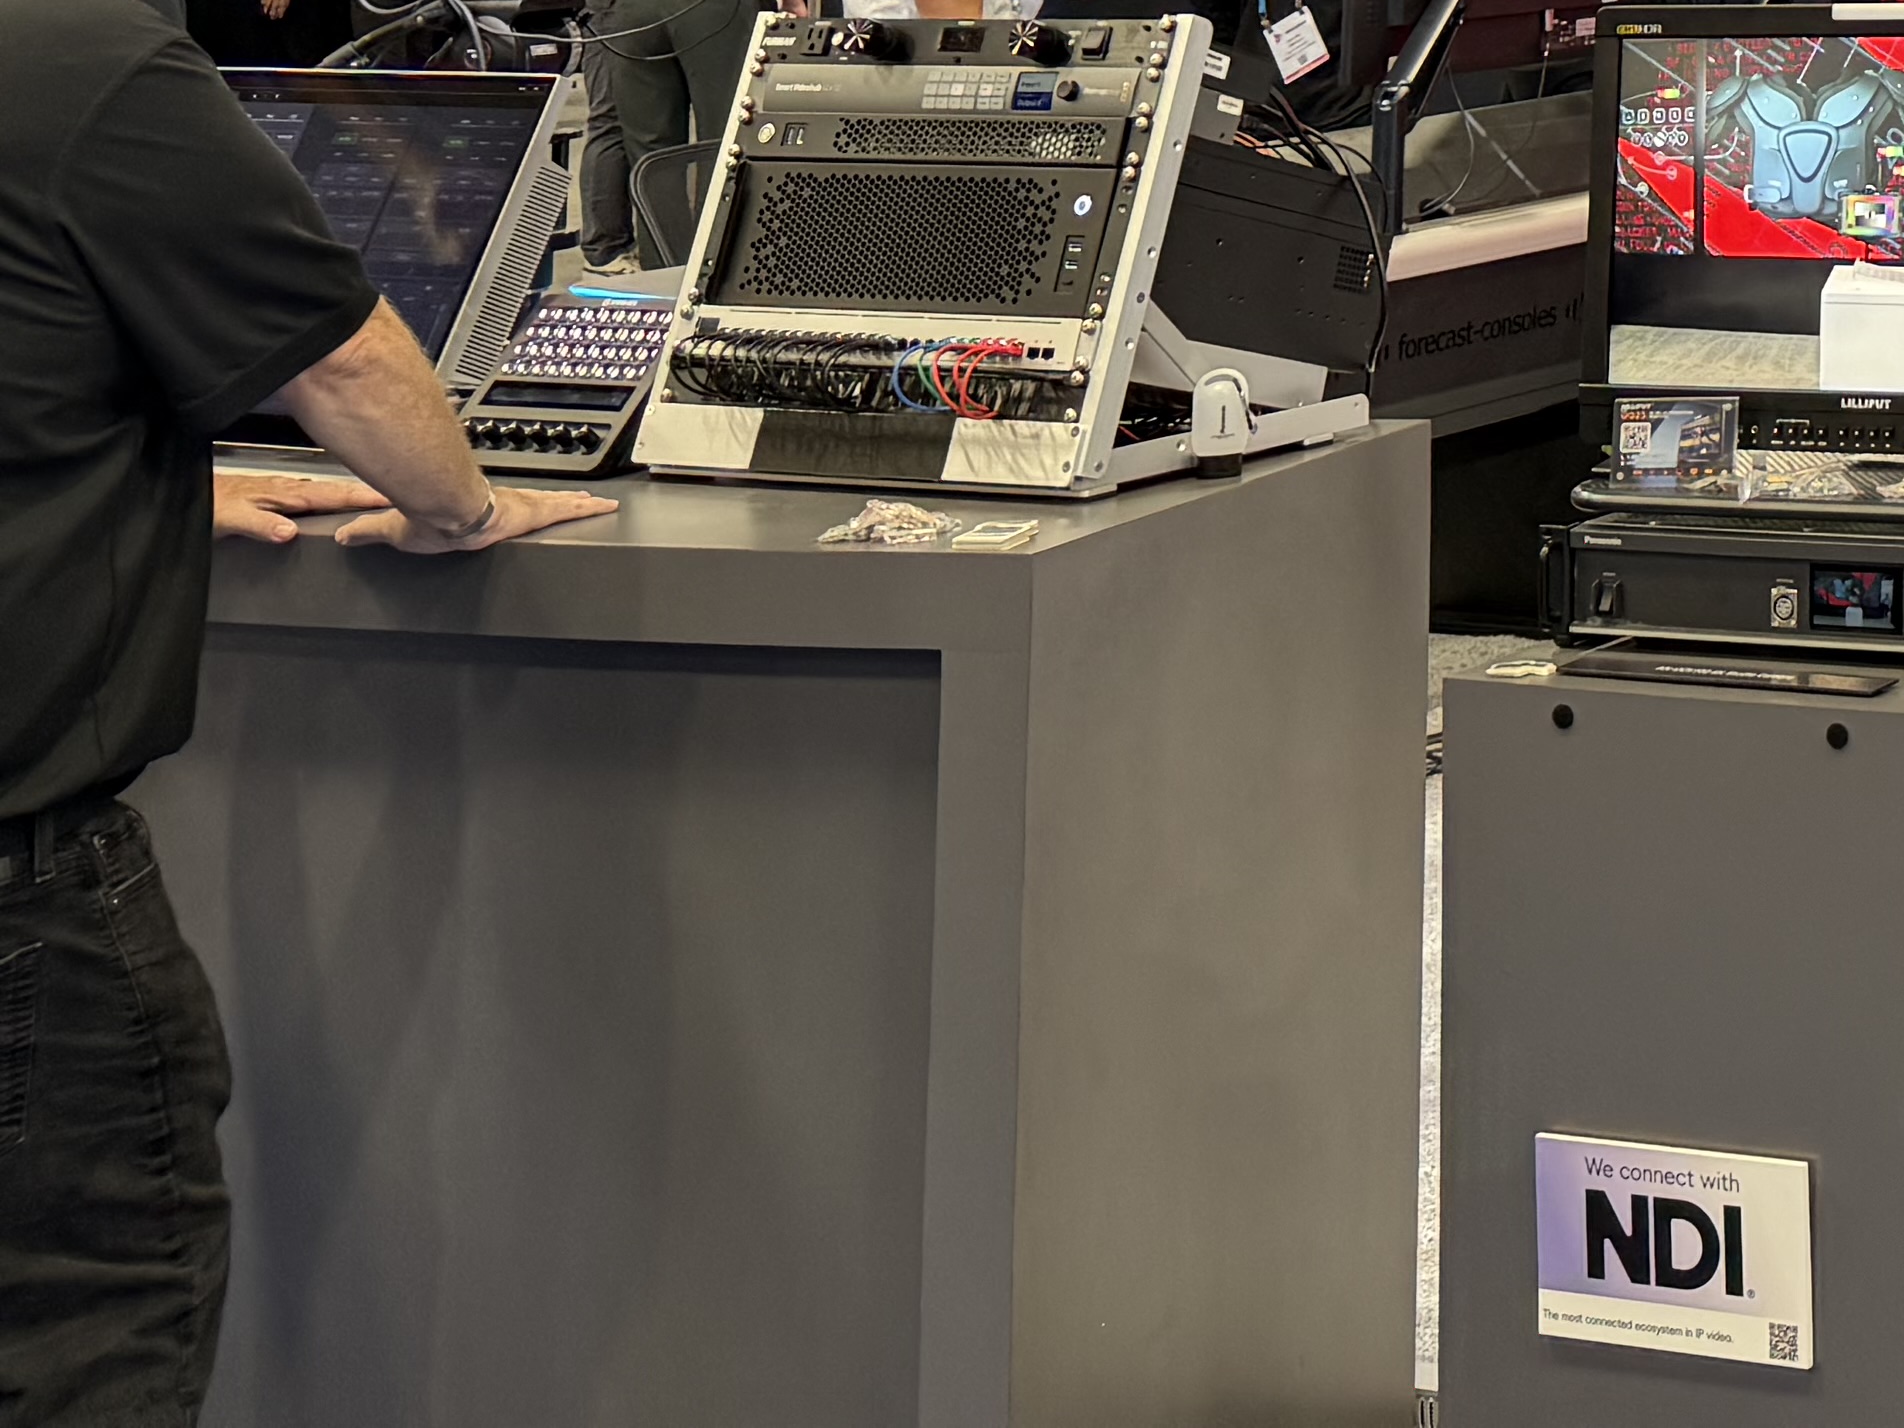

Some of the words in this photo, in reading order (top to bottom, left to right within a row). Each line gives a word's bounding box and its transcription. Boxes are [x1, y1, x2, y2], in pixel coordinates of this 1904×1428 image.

[1398, 304, 1557, 361] forecast-consoles
[1840, 397, 1892, 410] LILLIPUT
[1584, 1155, 1614, 1179] We
[1619, 1165, 1694, 1188] connect
[1700, 1171, 1741, 1193] with
[1585, 1188, 1744, 1297] NDI
[1543, 1308, 1560, 1322] The
[1561, 1312, 1584, 1324] most
[1585, 1315, 1633, 1331] connected
[1634, 1321, 1684, 1338] ecosystem
[1684, 1327, 1694, 1338] in
[1695, 1327, 1705, 1339] IP
[1706, 1330, 1735, 1344] video.
